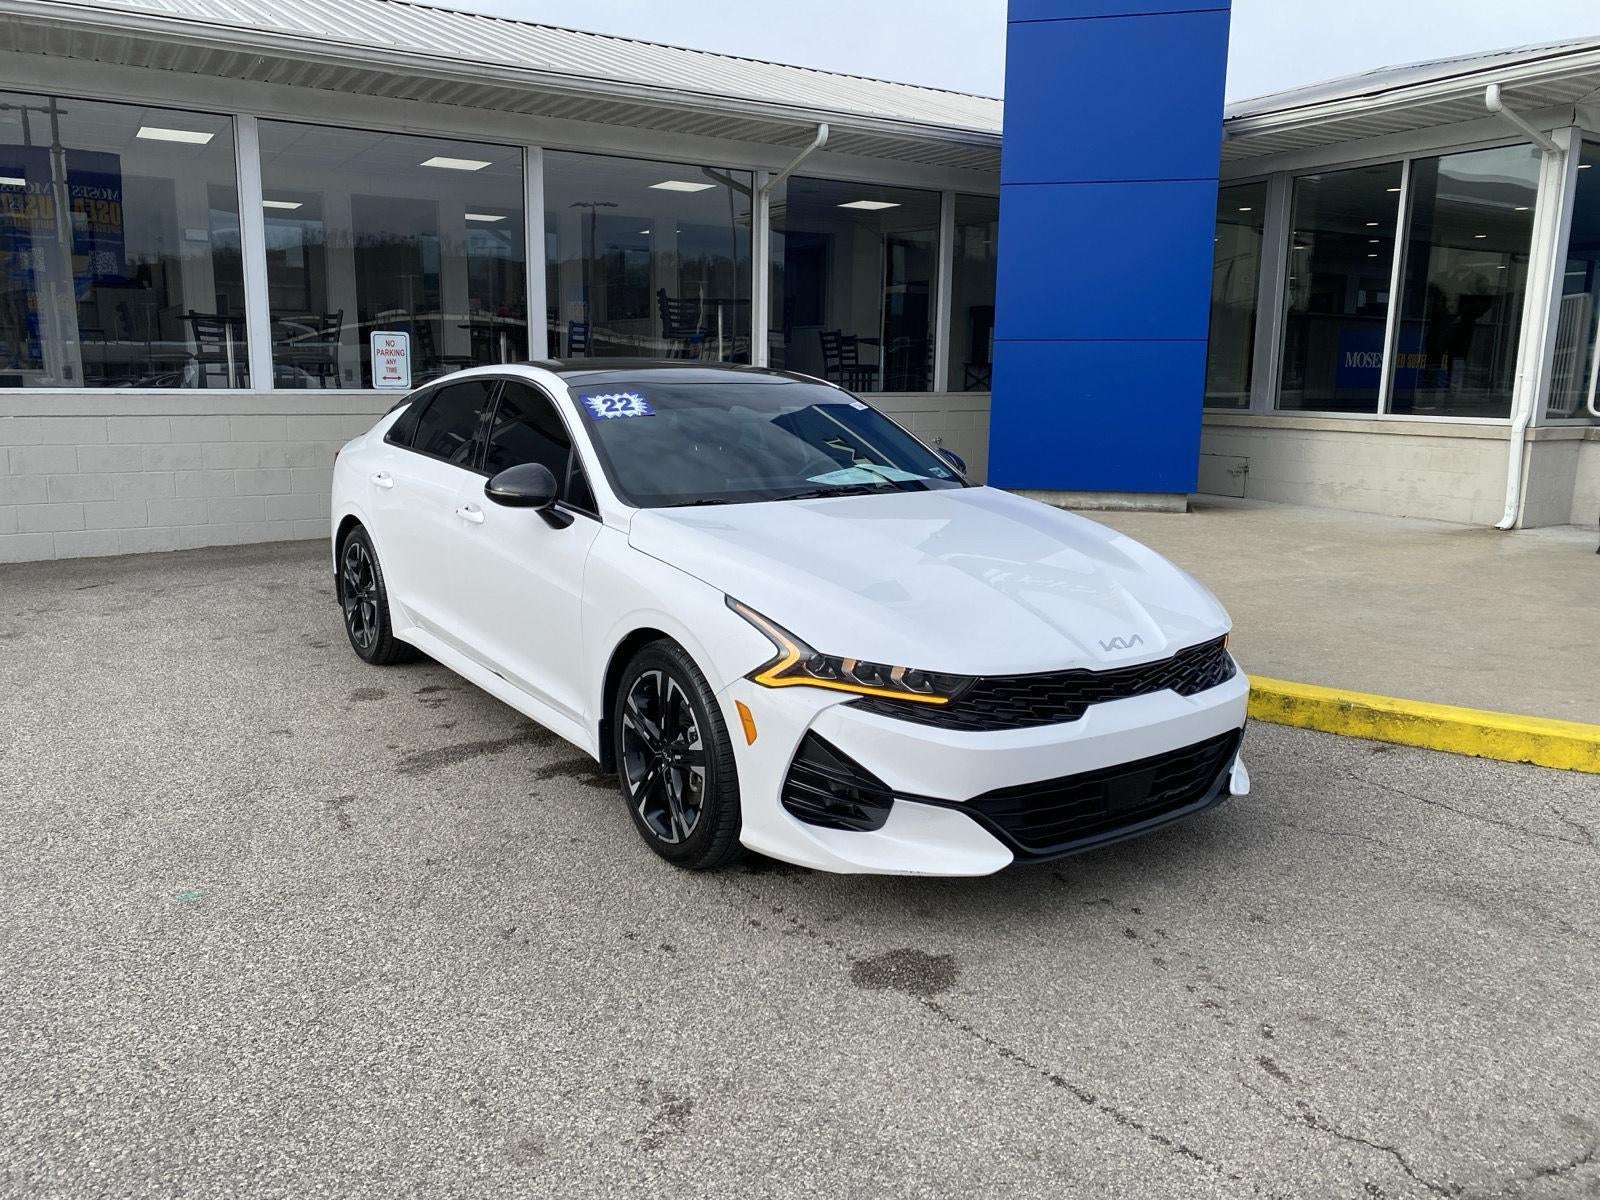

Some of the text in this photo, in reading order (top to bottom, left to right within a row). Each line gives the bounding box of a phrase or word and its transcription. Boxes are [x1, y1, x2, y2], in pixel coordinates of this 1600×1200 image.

[376, 348, 406, 357] PARKING
[385, 366, 398, 374] TIME
[602, 397, 635, 413] 22
